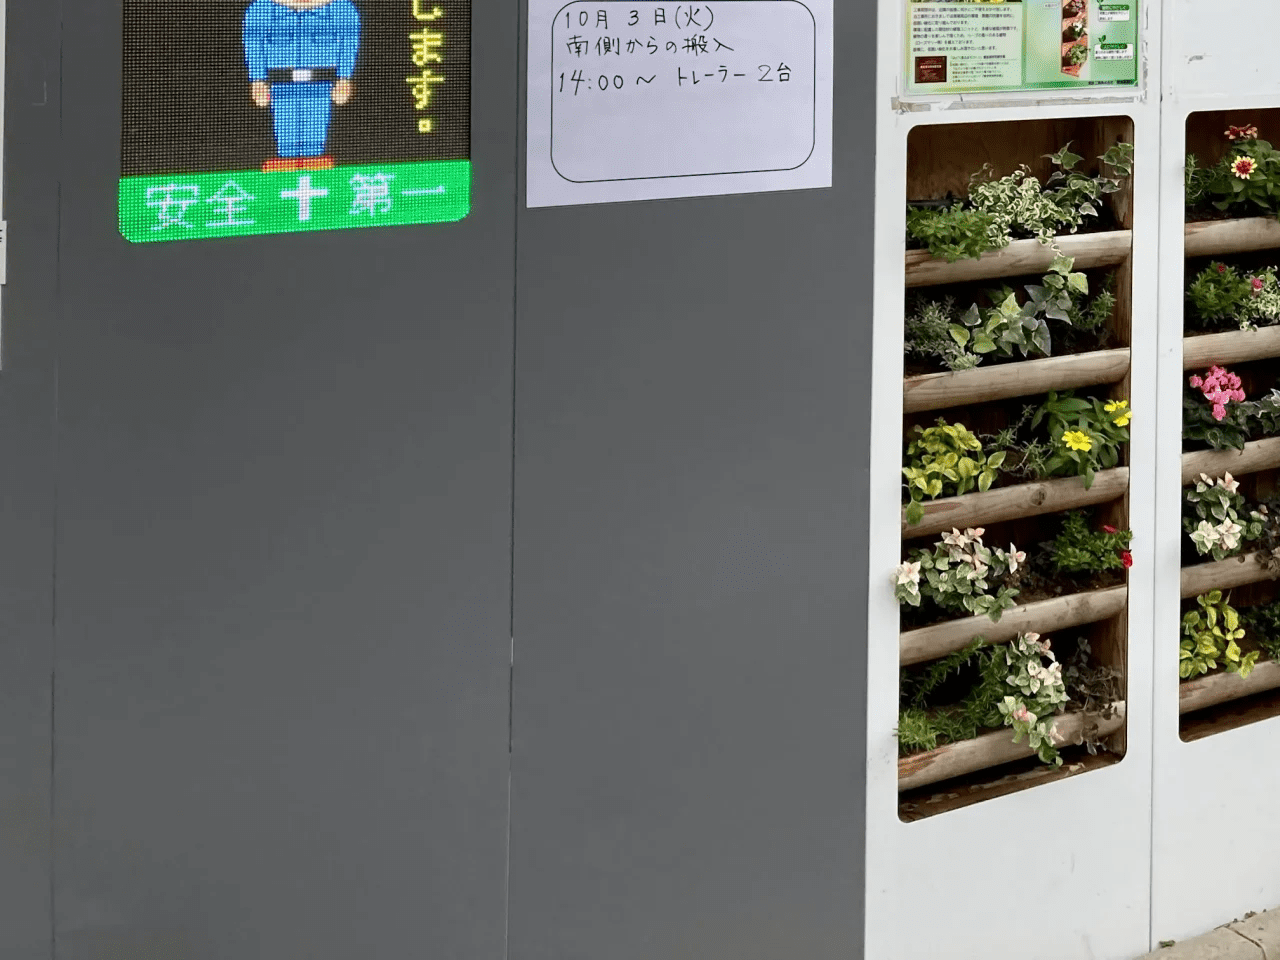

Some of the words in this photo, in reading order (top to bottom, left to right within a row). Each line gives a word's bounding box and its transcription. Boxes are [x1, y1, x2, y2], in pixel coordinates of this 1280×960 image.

[566, 34, 735, 58] 南側からの搬入
